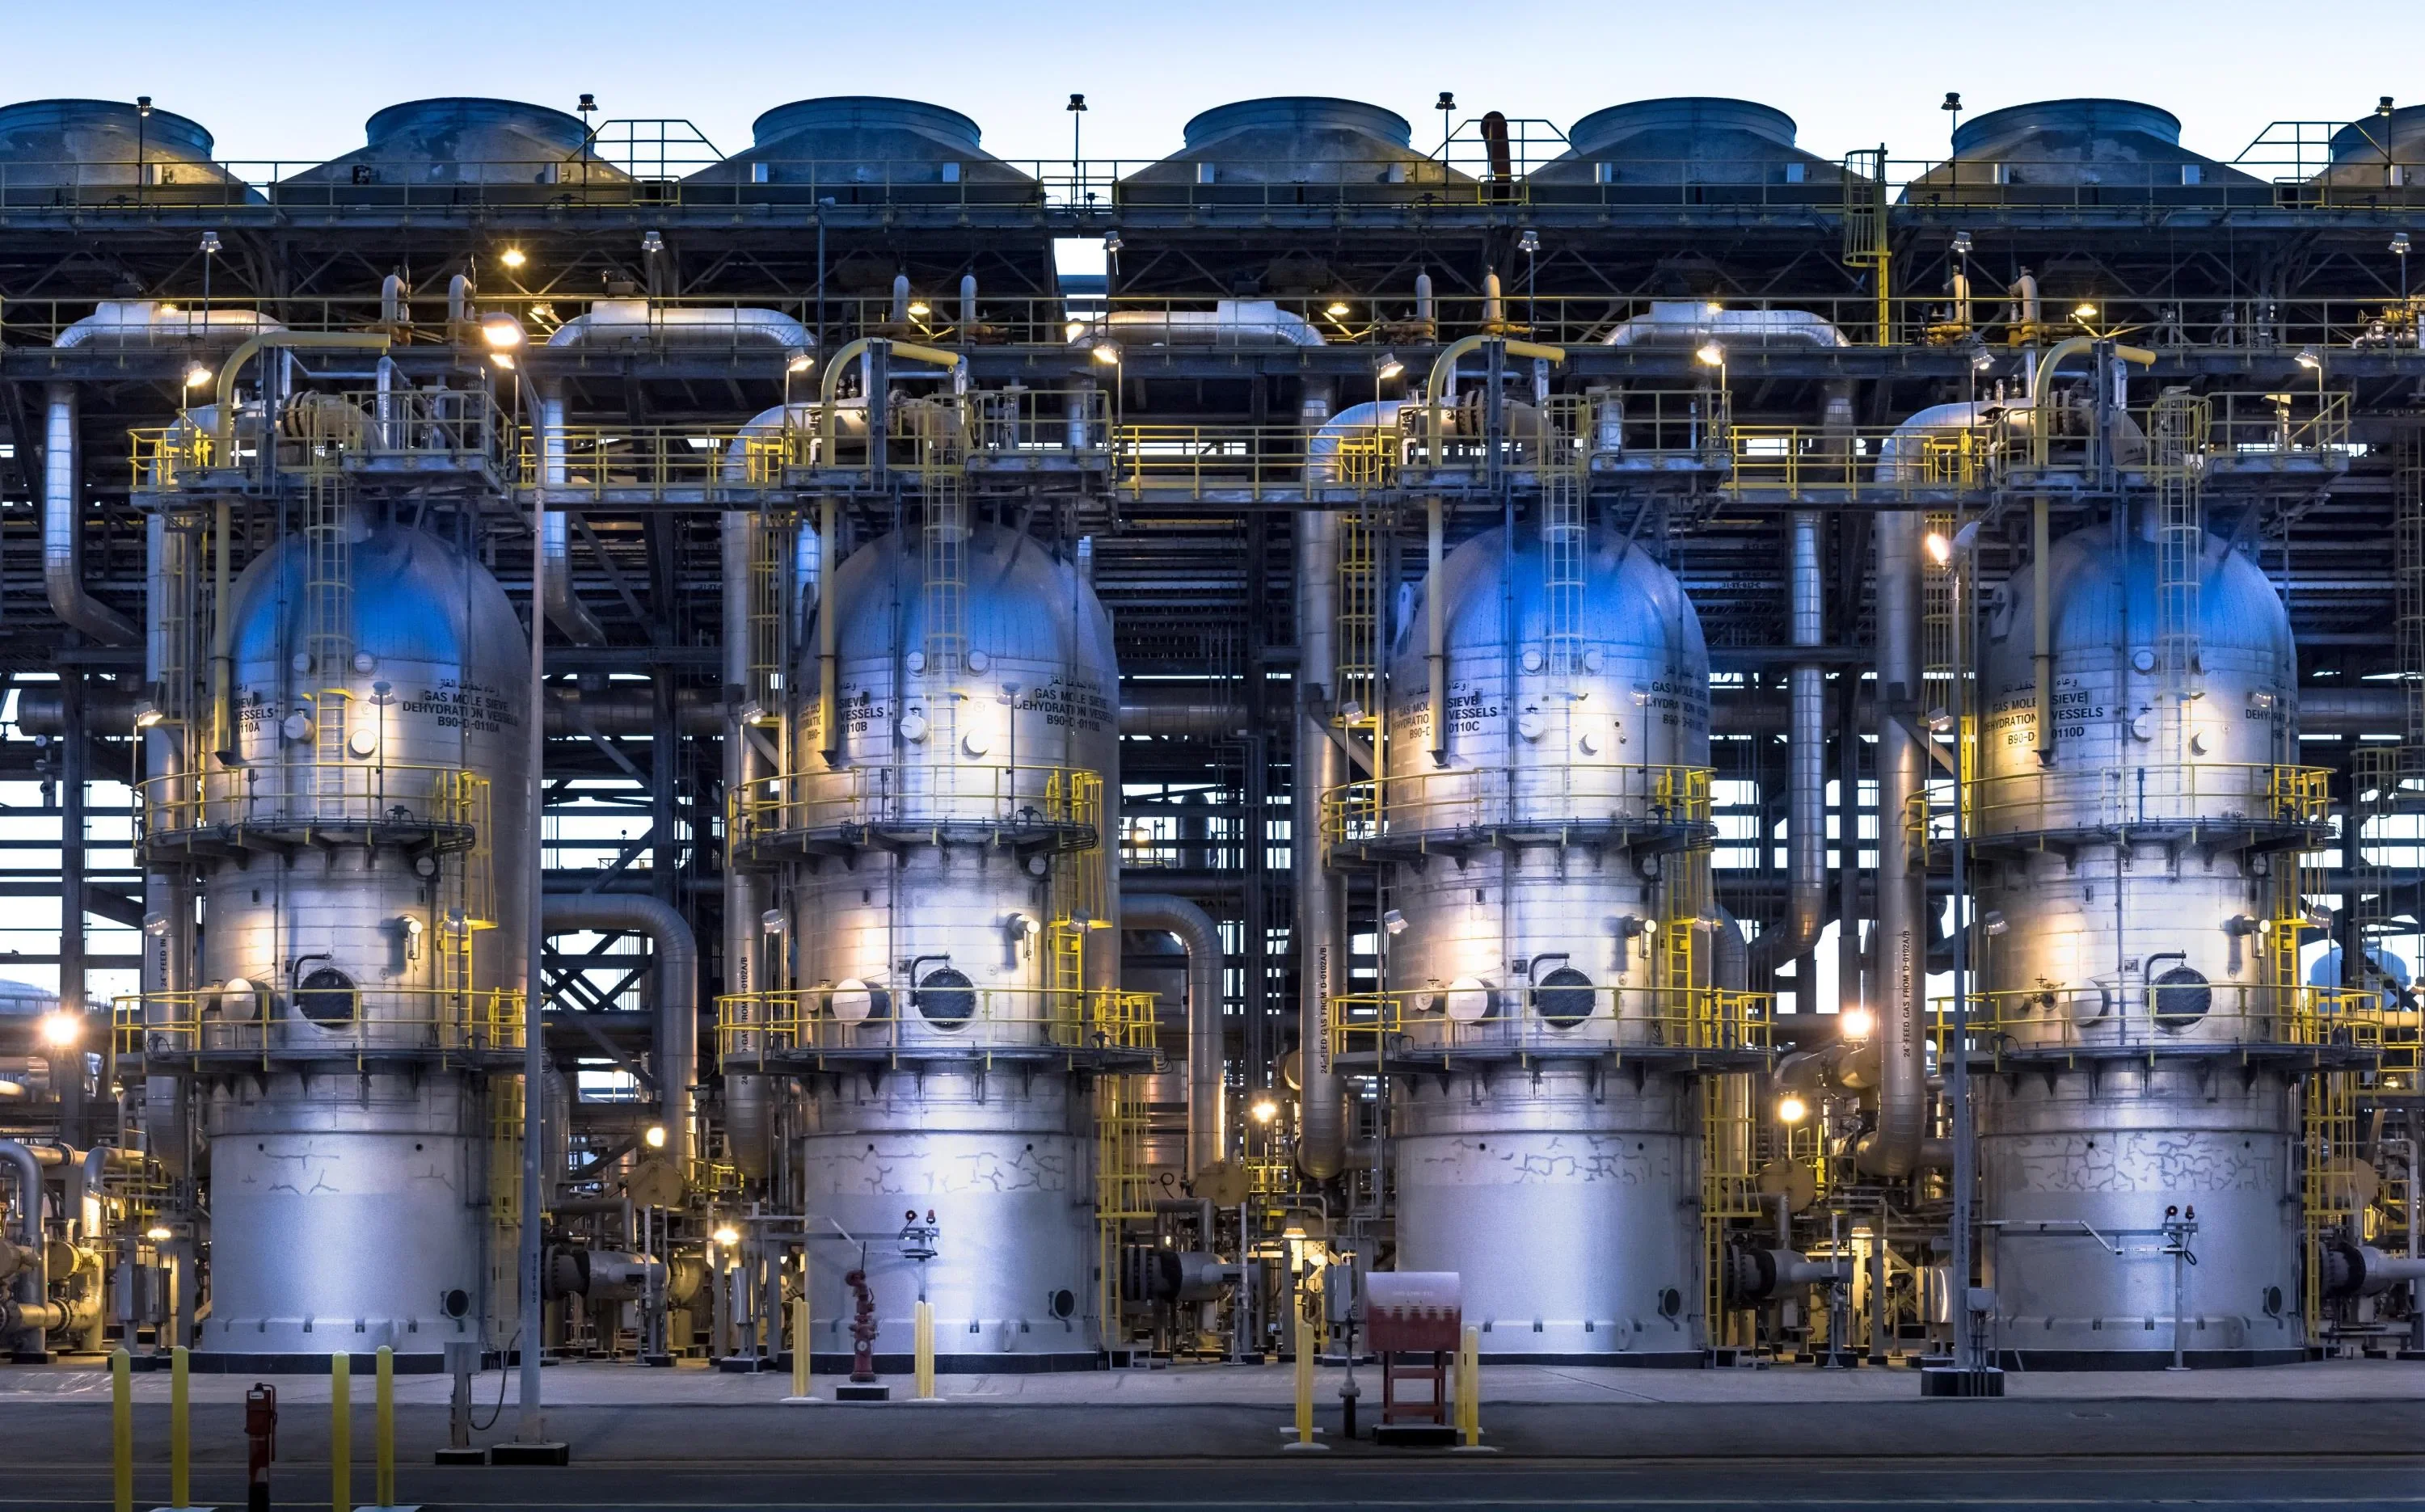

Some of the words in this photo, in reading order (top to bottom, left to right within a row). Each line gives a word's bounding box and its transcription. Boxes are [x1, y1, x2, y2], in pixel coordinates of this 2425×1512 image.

[1035, 688, 1056, 700] GAS
[1651, 681, 1671, 693] GAS
[424, 690, 447, 702] GAS
[453, 693, 481, 707] MOLE
[485, 697, 508, 712] SIEVE
[1413, 701, 1430, 713] MOL
[1993, 701, 2009, 714] GAS
[2011, 697, 2036, 710] MOLE
[2052, 691, 2086, 706] SIEVE
[487, 710, 518, 727] VESSELS
[840, 706, 884, 722] VESSELS
[1449, 706, 1498, 721] VESSELS
[1983, 713, 2036, 733] DEHYDRATION
[2051, 706, 2103, 721] VESSELS
[841, 721, 868, 735] 0110B
[1449, 720, 1480, 735] 0110C
[2052, 727, 2085, 739] 0110D
[159, 938, 167, 947] IN
[1902, 930, 1911, 971] D-0102A/B
[1319, 947, 1327, 988] D-0102A/B
